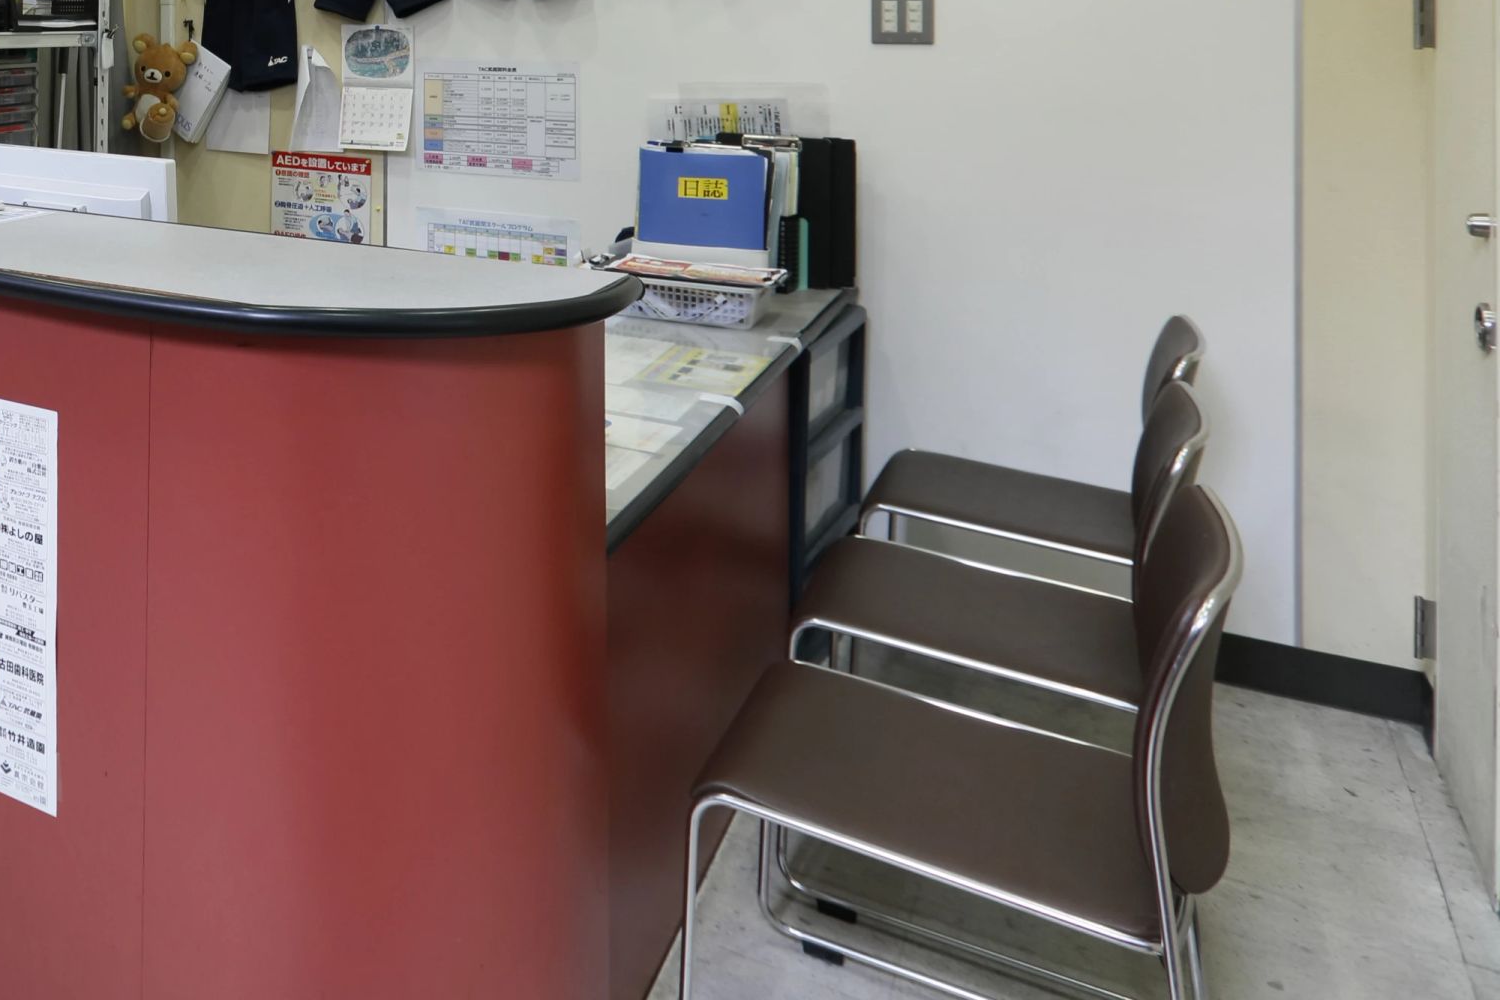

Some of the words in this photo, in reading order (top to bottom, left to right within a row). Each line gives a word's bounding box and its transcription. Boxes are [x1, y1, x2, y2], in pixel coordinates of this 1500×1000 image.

[276, 154, 367, 172] AEDを設置しています
[683, 179, 724, 198] 日誌
